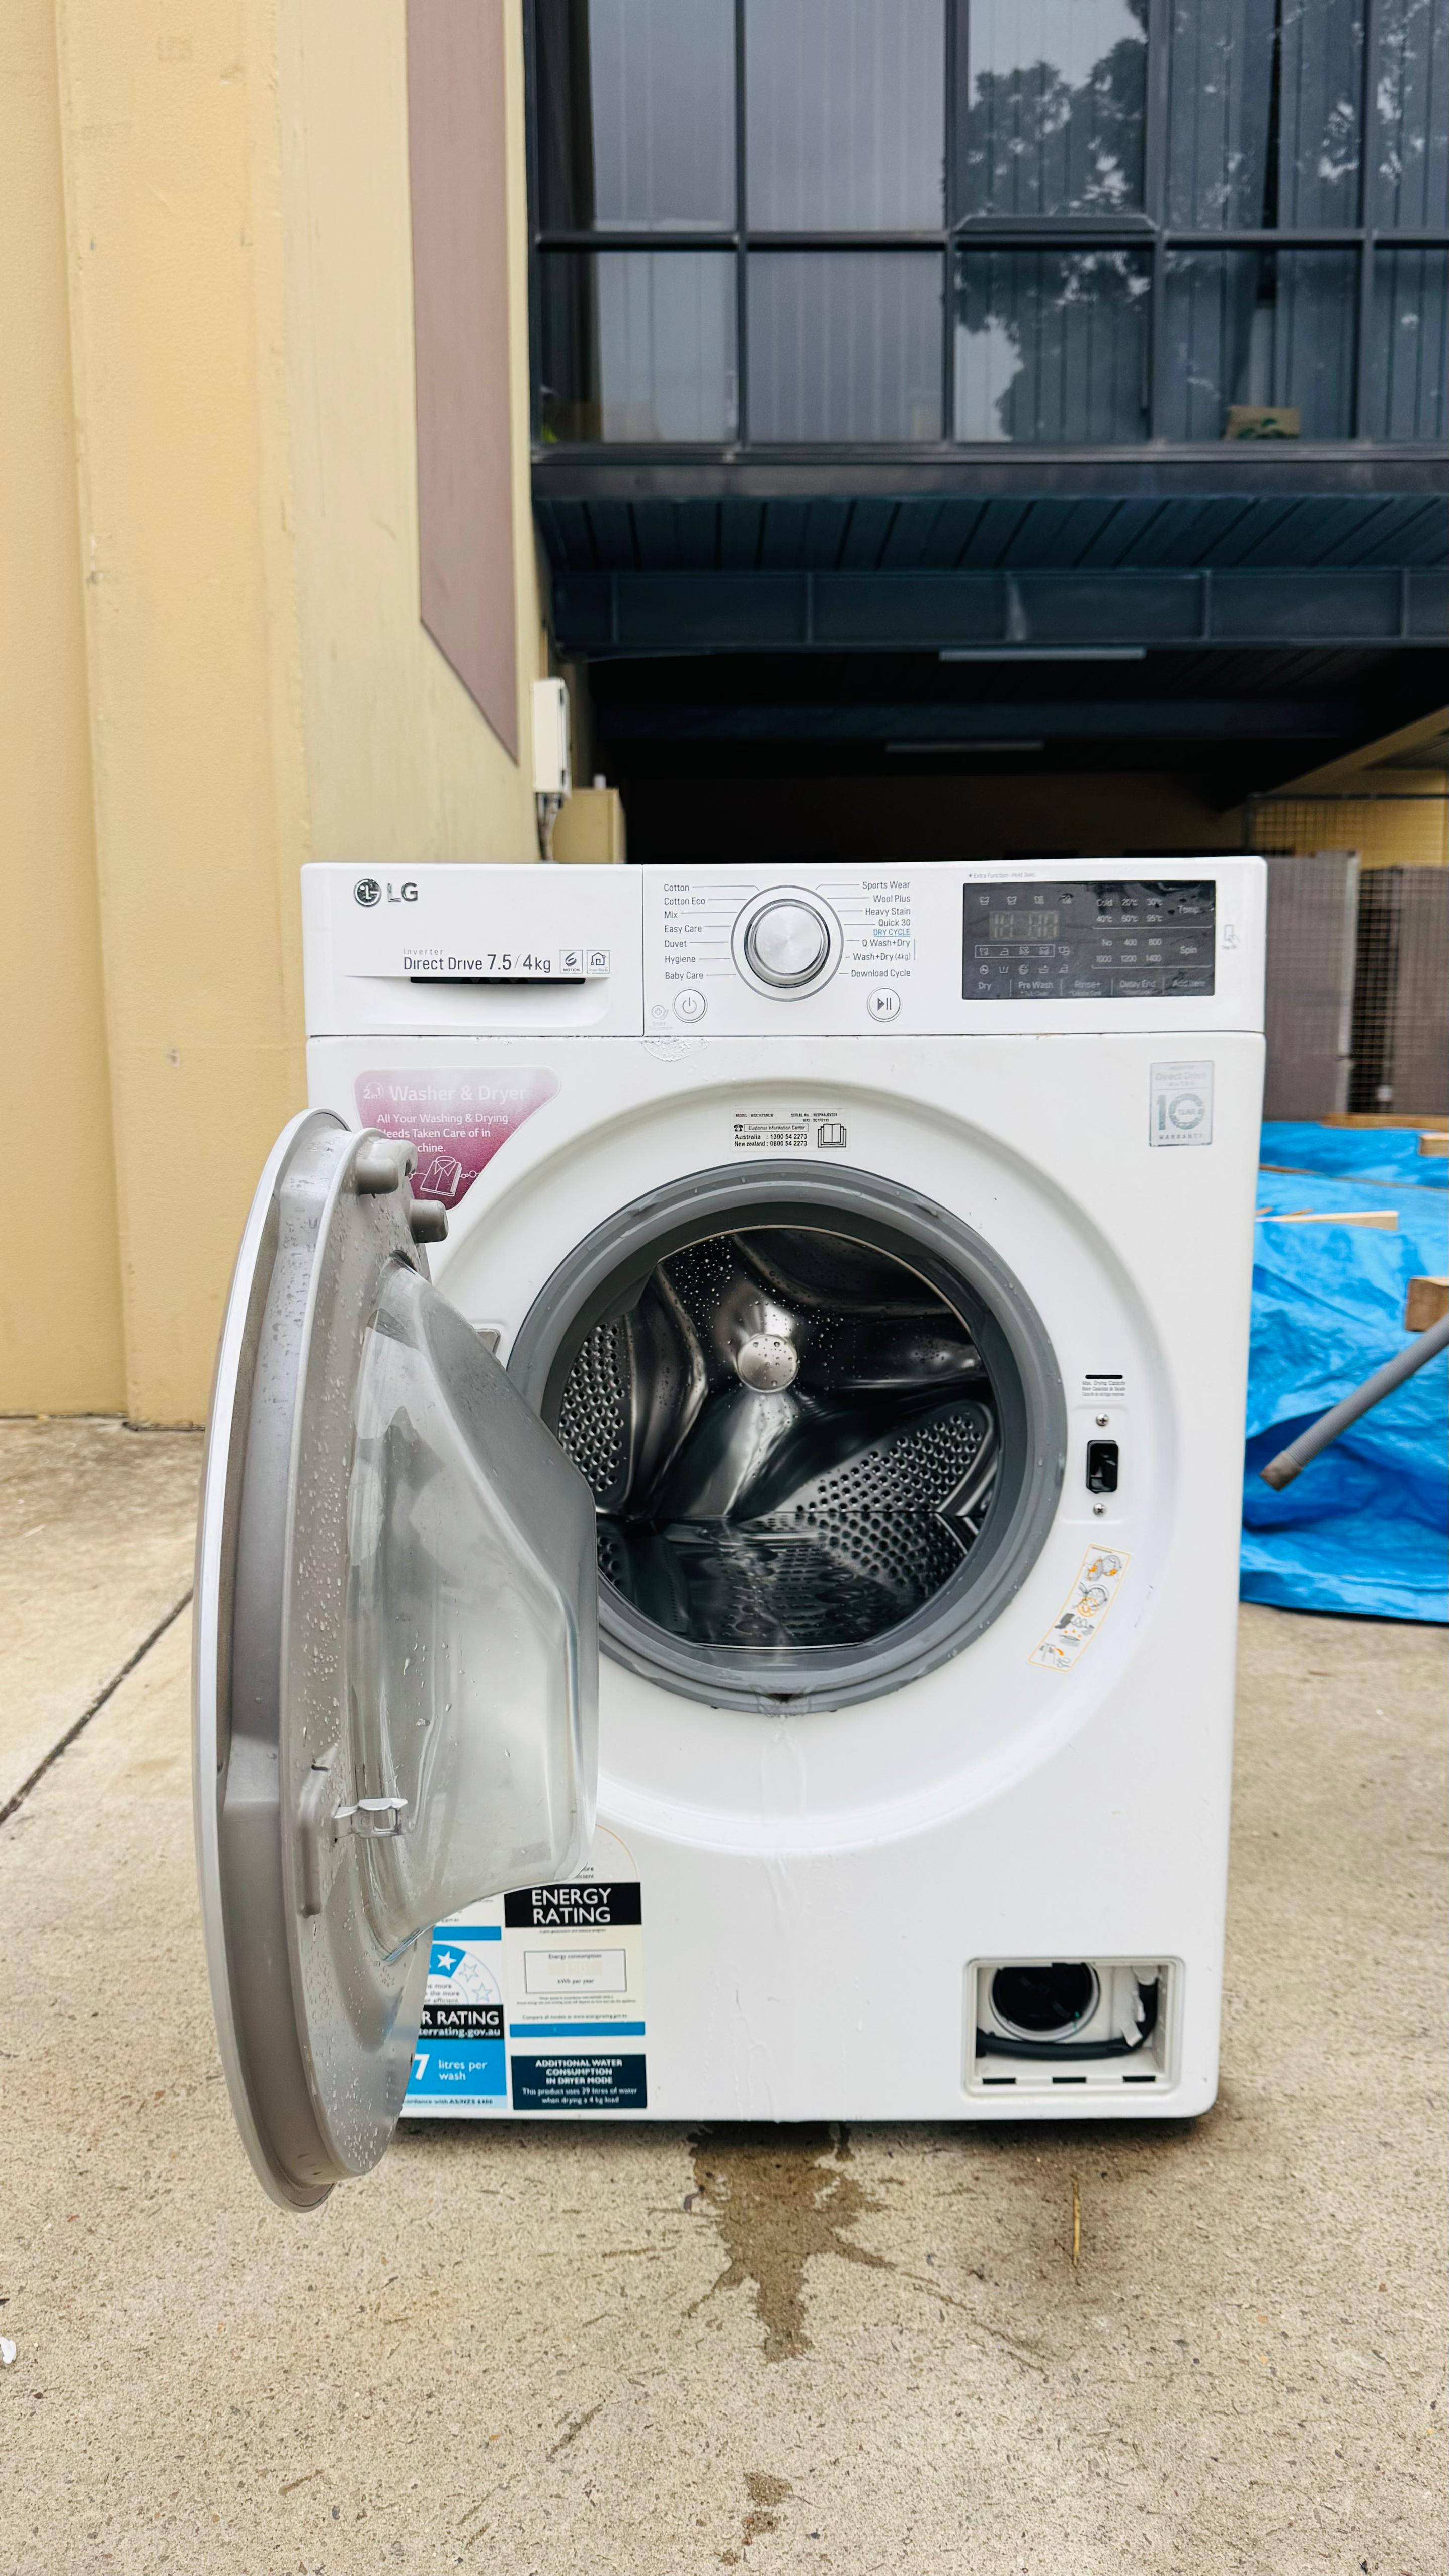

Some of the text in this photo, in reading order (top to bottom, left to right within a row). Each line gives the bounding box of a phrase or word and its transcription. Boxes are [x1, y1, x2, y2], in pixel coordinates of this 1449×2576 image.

[664, 883, 689, 892] Cotton
[862, 881, 888, 891] Sports
[387, 882, 419, 902] LG
[664, 897, 705, 905] Cotton Eco
[873, 895, 893, 903] Wool
[664, 911, 678, 919] Mix
[865, 907, 911, 917] Heavy Stain
[878, 919, 899, 927] Quick
[664, 925, 683, 934] Easy
[1179, 946, 1198, 955] Spin
[404, 957, 444, 970] Direct
[448, 957, 482, 970] Drive
[665, 955, 696, 964] Hygiene
[665, 971, 704, 981] Baby Care
[851, 969, 911, 978] Download Cycle
[978, 982, 992, 990] Dry
[1018, 981, 1031, 989] Pre
[389, 1085, 526, 1104] Washer & Dryer
[377, 1113, 508, 1125] All Your Washing & Drying
[412, 1129, 441, 1138] Taken
[443, 1129, 467, 1138] Care
[469, 1128, 478, 1137] of
[481, 1128, 491, 1137] in
[417, 1143, 446, 1152] chine.
[532, 1888, 612, 1905] ENERGY
[533, 1906, 611, 1924] RATING
[437, 2010, 500, 2025] RATING
[438, 2059, 488, 2072] litres per
[535, 2058, 623, 2067] ADDITIONAL WATER
[439, 2071, 466, 2080] wash
[546, 2068, 613, 2076] CONSUMPTION
[546, 2076, 613, 2085] IN DRYER MODE
[537, 2087, 564, 2097] product
[609, 2086, 617, 2094] of
[560, 2096, 582, 2105] drying
[595, 2096, 604, 2105] kg
[604, 2095, 619, 2103] load
